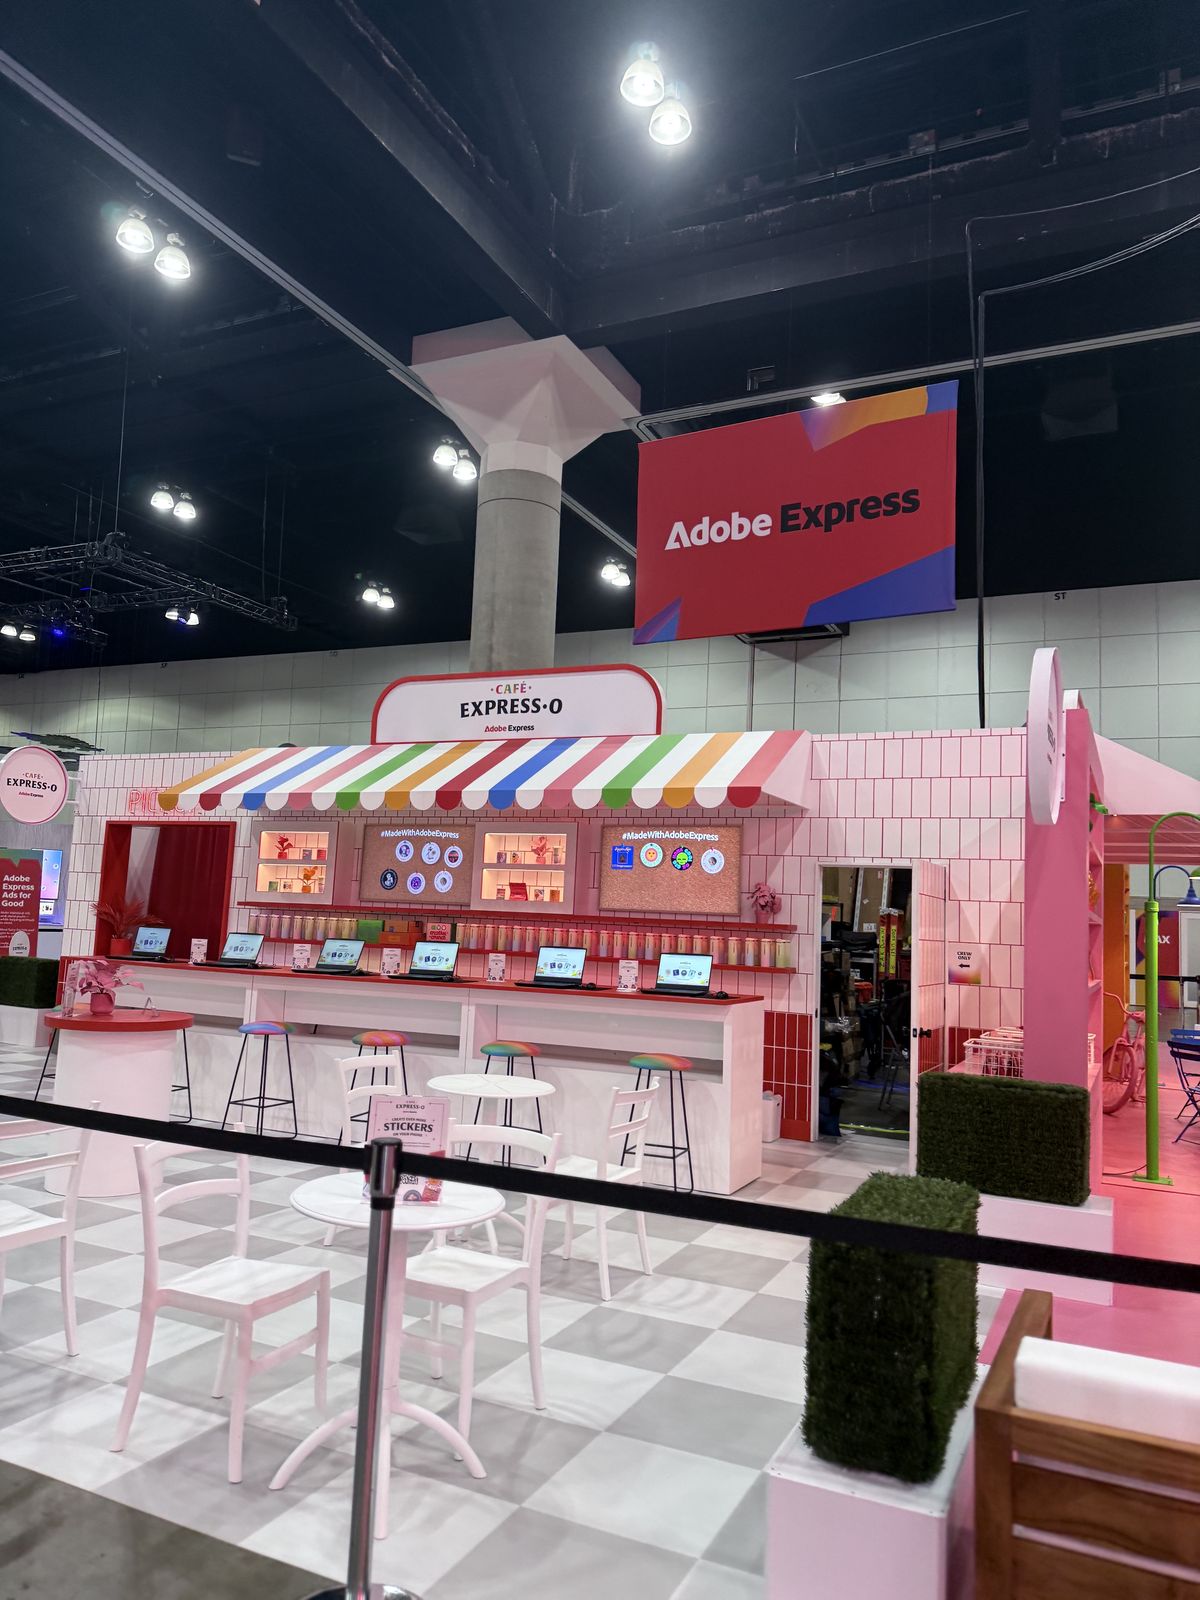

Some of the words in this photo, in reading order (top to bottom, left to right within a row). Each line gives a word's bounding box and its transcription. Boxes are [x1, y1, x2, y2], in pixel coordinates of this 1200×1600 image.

[664, 511, 772, 551] Adobe
[780, 488, 921, 533] Express
[1054, 591, 1067, 601] ST
[495, 680, 527, 695] CAFÉ
[484, 725, 507, 733] Adobe
[507, 724, 535, 733] Express
[380, 828, 460, 839] #MadeWithAdobeExpress
[622, 830, 719, 842] #MadeWithAdobeExpress
[3, 874, 31, 882] Adobe
[2, 883, 35, 892] Express
[2, 891, 18, 899] Ads
[19, 891, 32, 899] for
[384, 1122, 434, 1133] STICKERS
